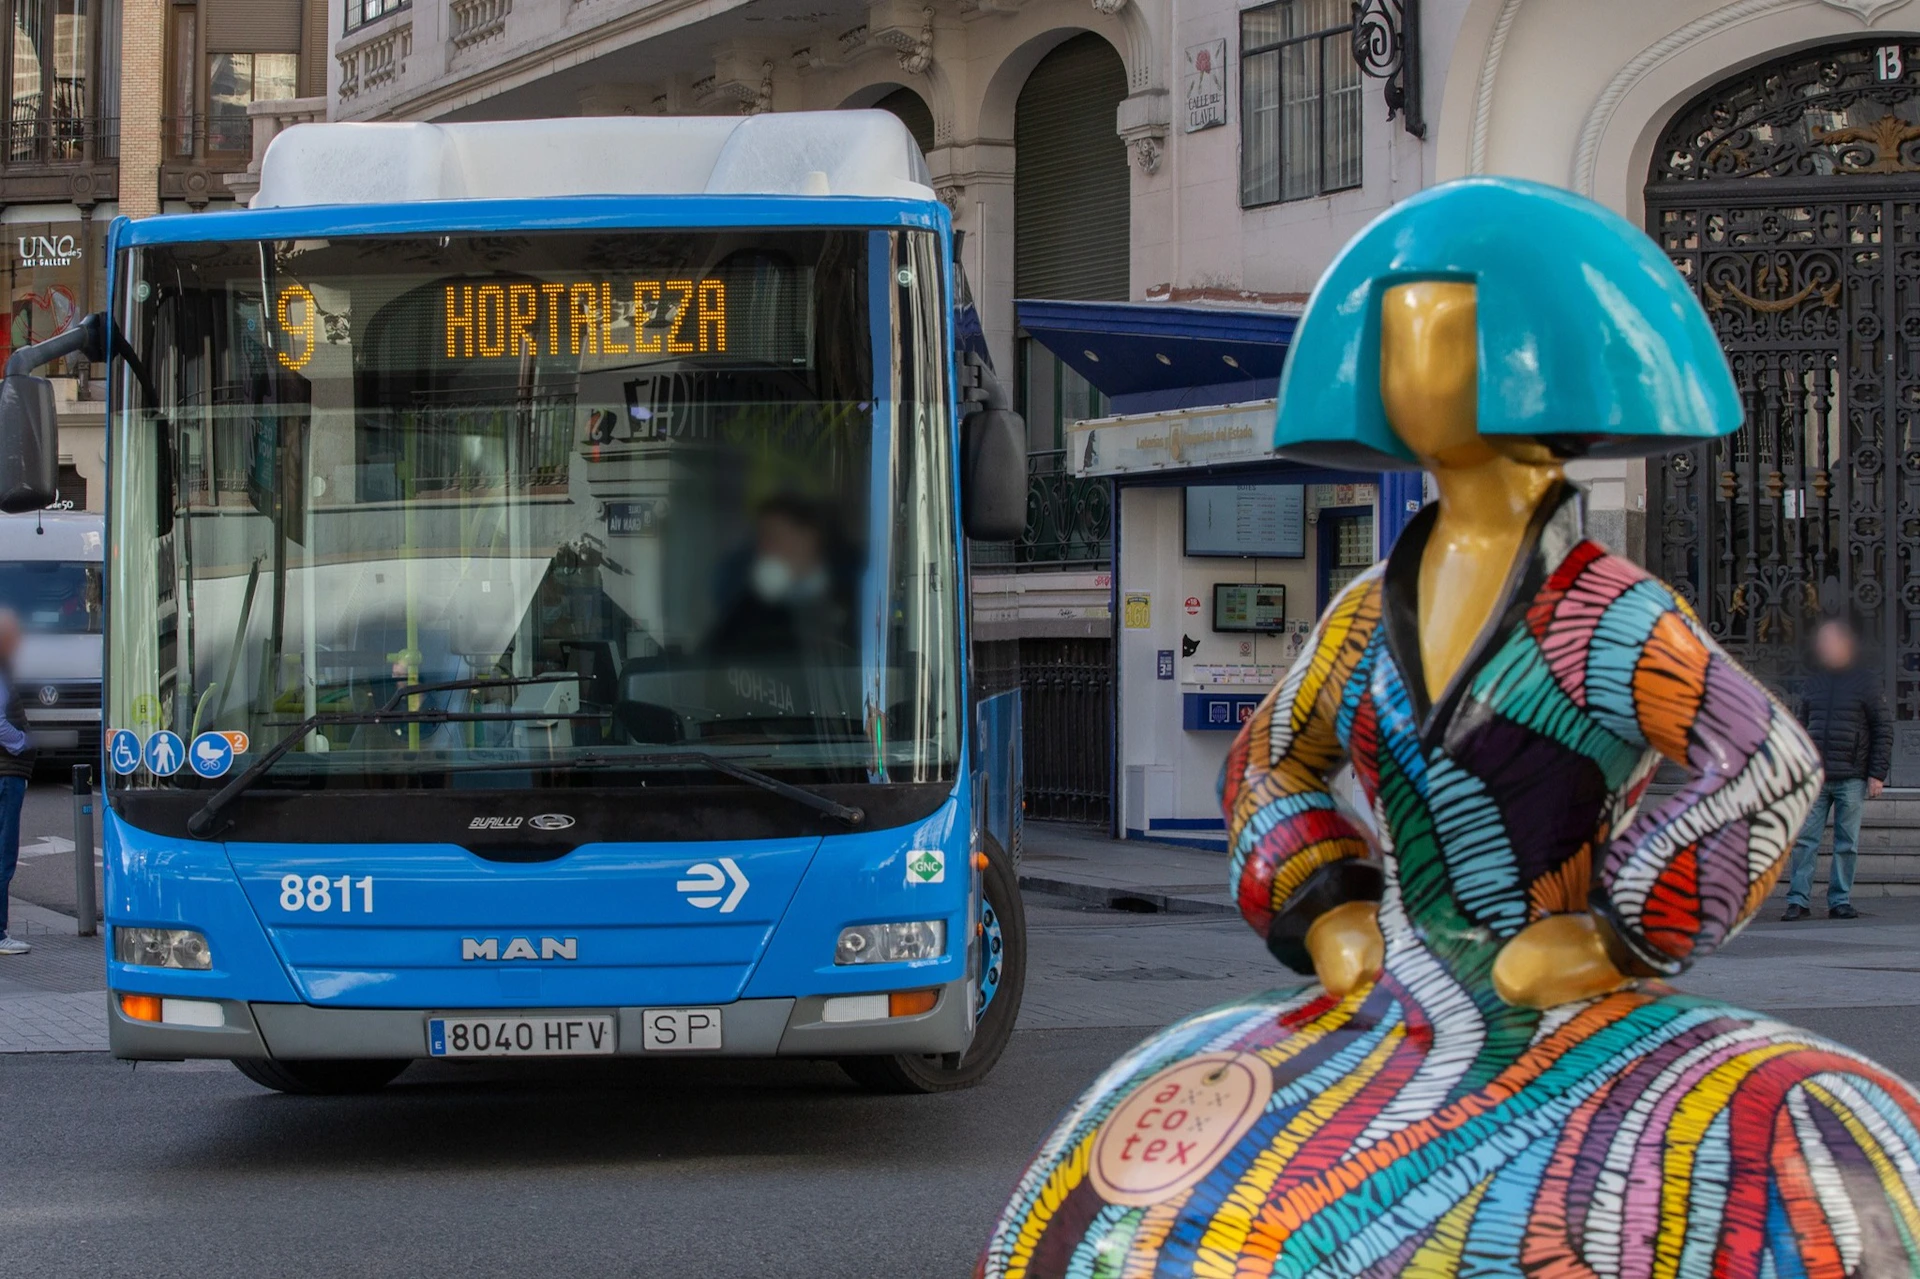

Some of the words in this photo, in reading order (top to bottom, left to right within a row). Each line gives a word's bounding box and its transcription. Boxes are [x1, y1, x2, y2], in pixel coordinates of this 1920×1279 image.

[1875, 45, 1902, 80] 13
[1188, 93, 1209, 111] CALLE
[1209, 93, 1220, 104] DEL
[1190, 106, 1219, 127] CLAVEL
[18, 235, 74, 258] UNO
[40, 258, 70, 266] GALLERY
[278, 285, 315, 370] 9
[445, 279, 726, 358] HORTALEZA
[1227, 424, 1253, 440] Estado
[1126, 605, 1149, 626] 160
[233, 735, 243, 747] 2
[915, 861, 939, 873] GNC
[280, 874, 373, 913] 8811
[462, 938, 577, 960] MAN
[435, 1041, 442, 1049] E
[452, 1023, 531, 1051] 8040
[544, 1021, 605, 1050] HFV
[1154, 1083, 1181, 1104] a
[1136, 1107, 1189, 1131] co
[1119, 1133, 1198, 1165] tex
